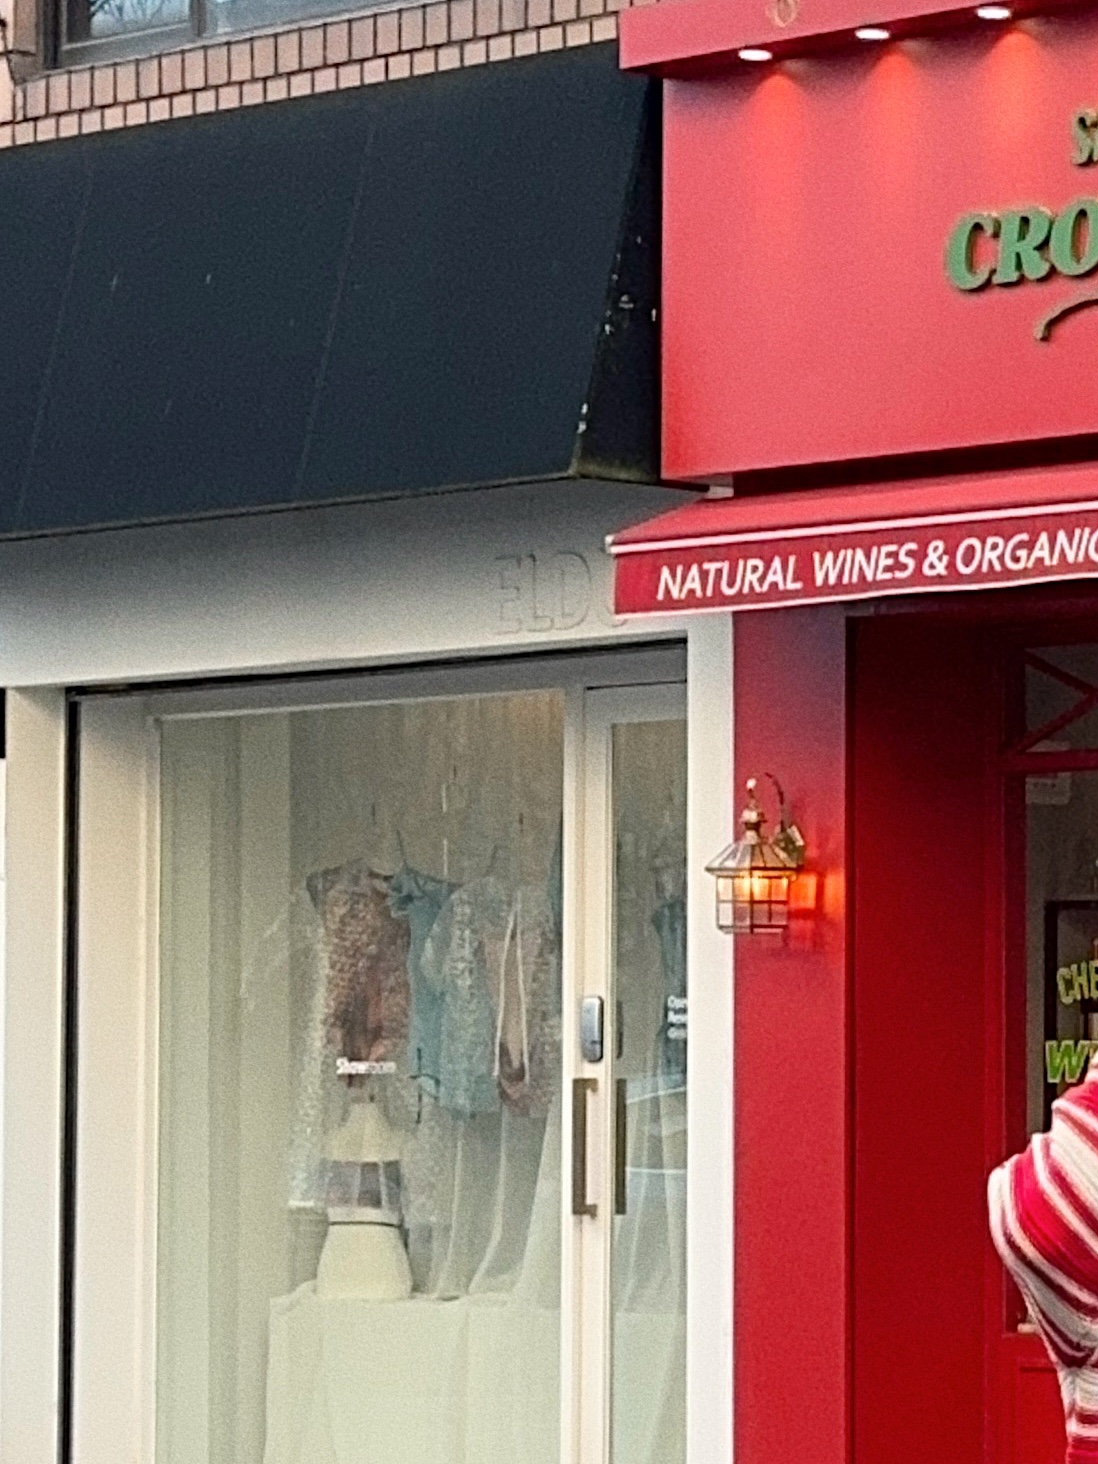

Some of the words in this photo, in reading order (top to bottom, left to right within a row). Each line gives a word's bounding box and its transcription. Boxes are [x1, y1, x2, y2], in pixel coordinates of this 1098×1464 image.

[656, 555, 803, 601] NATURAL
[812, 542, 915, 587] WINES
[921, 537, 949, 578] &
